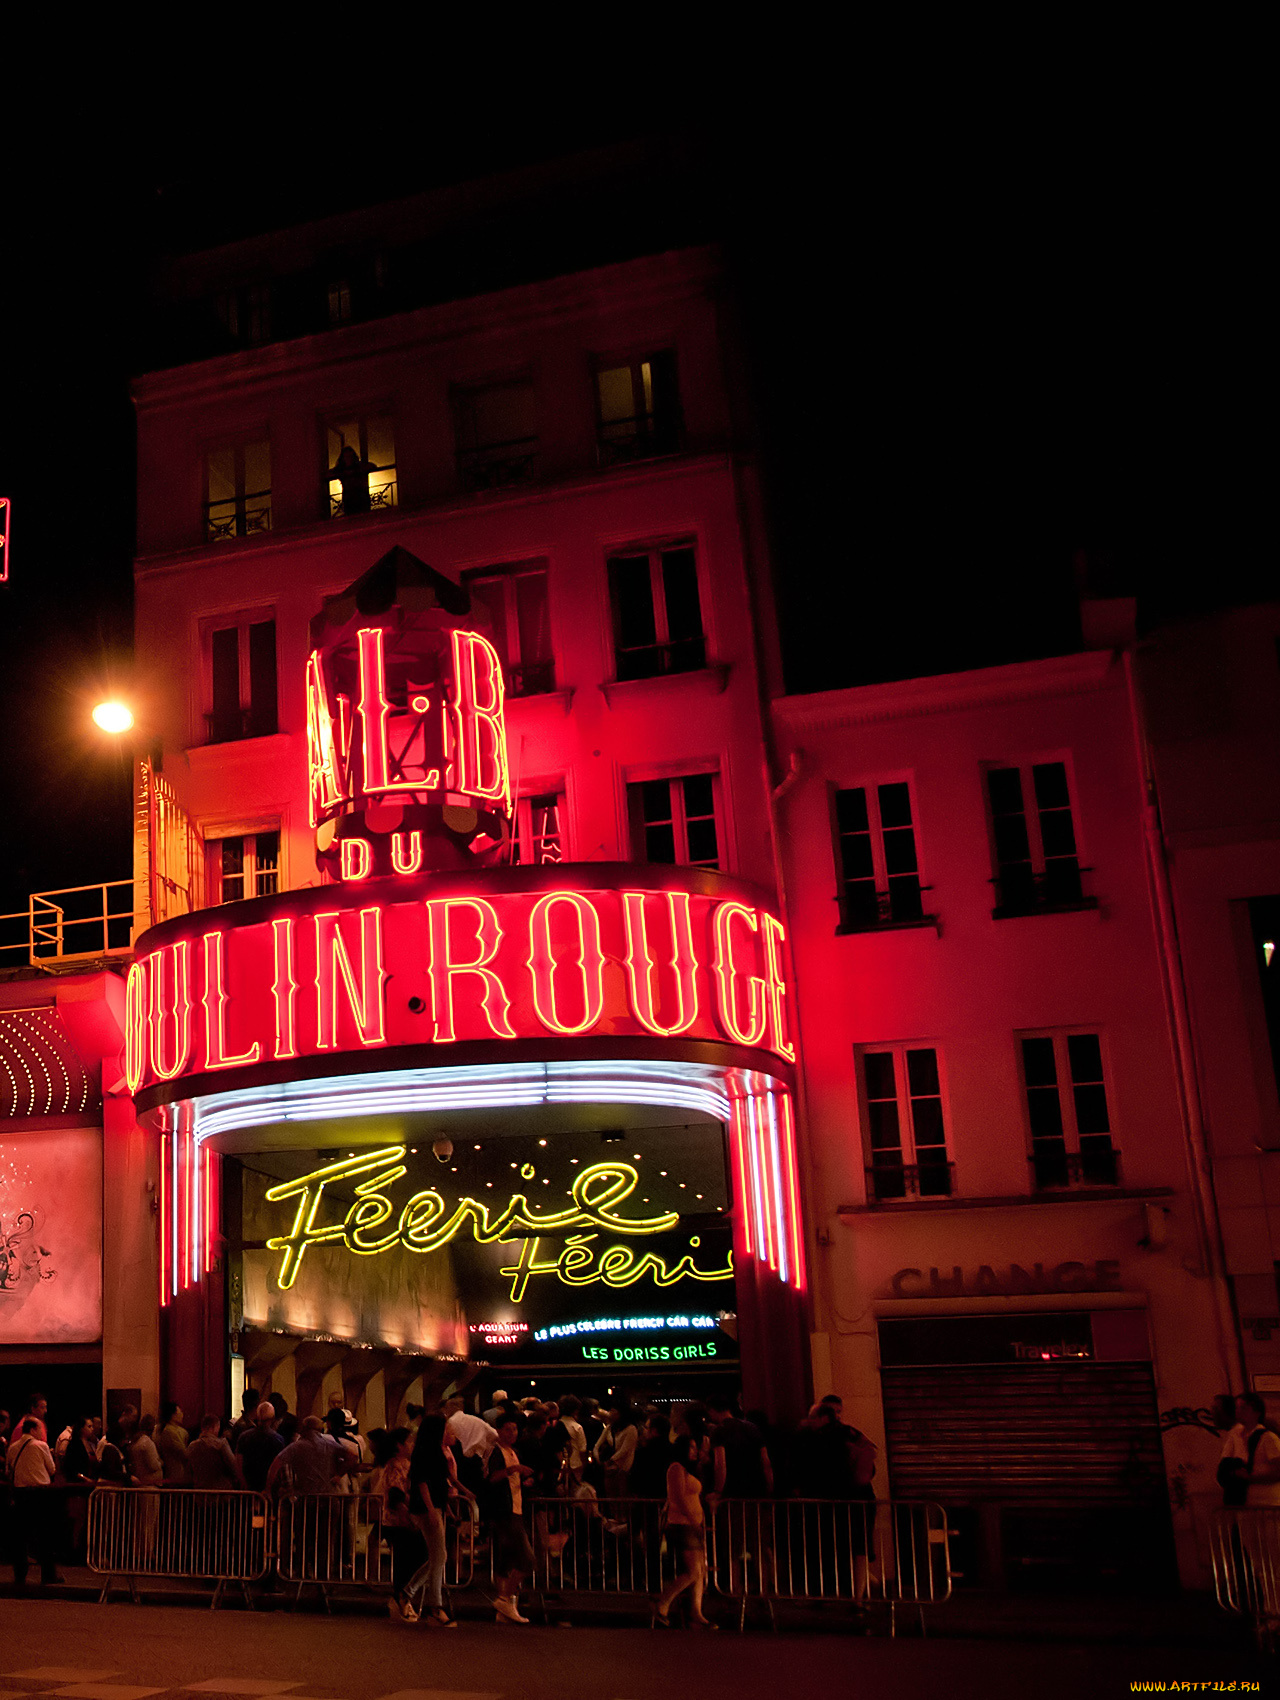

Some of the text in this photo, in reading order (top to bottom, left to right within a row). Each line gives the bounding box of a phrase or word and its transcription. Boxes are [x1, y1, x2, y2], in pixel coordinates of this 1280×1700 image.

[340, 831, 423, 881] DU
[425, 891, 795, 1062] ROUGE
[266, 1144, 680, 1291] Féerie
[498, 1232, 735, 1304] Féeri
[891, 1260, 1120, 1298] CHANGE
[534, 1328, 549, 1341] LE
[549, 1323, 577, 1338] PLUS
[622, 1316, 665, 1330] FRENCH
[582, 1341, 717, 1361] LES DORISS GIRLS
